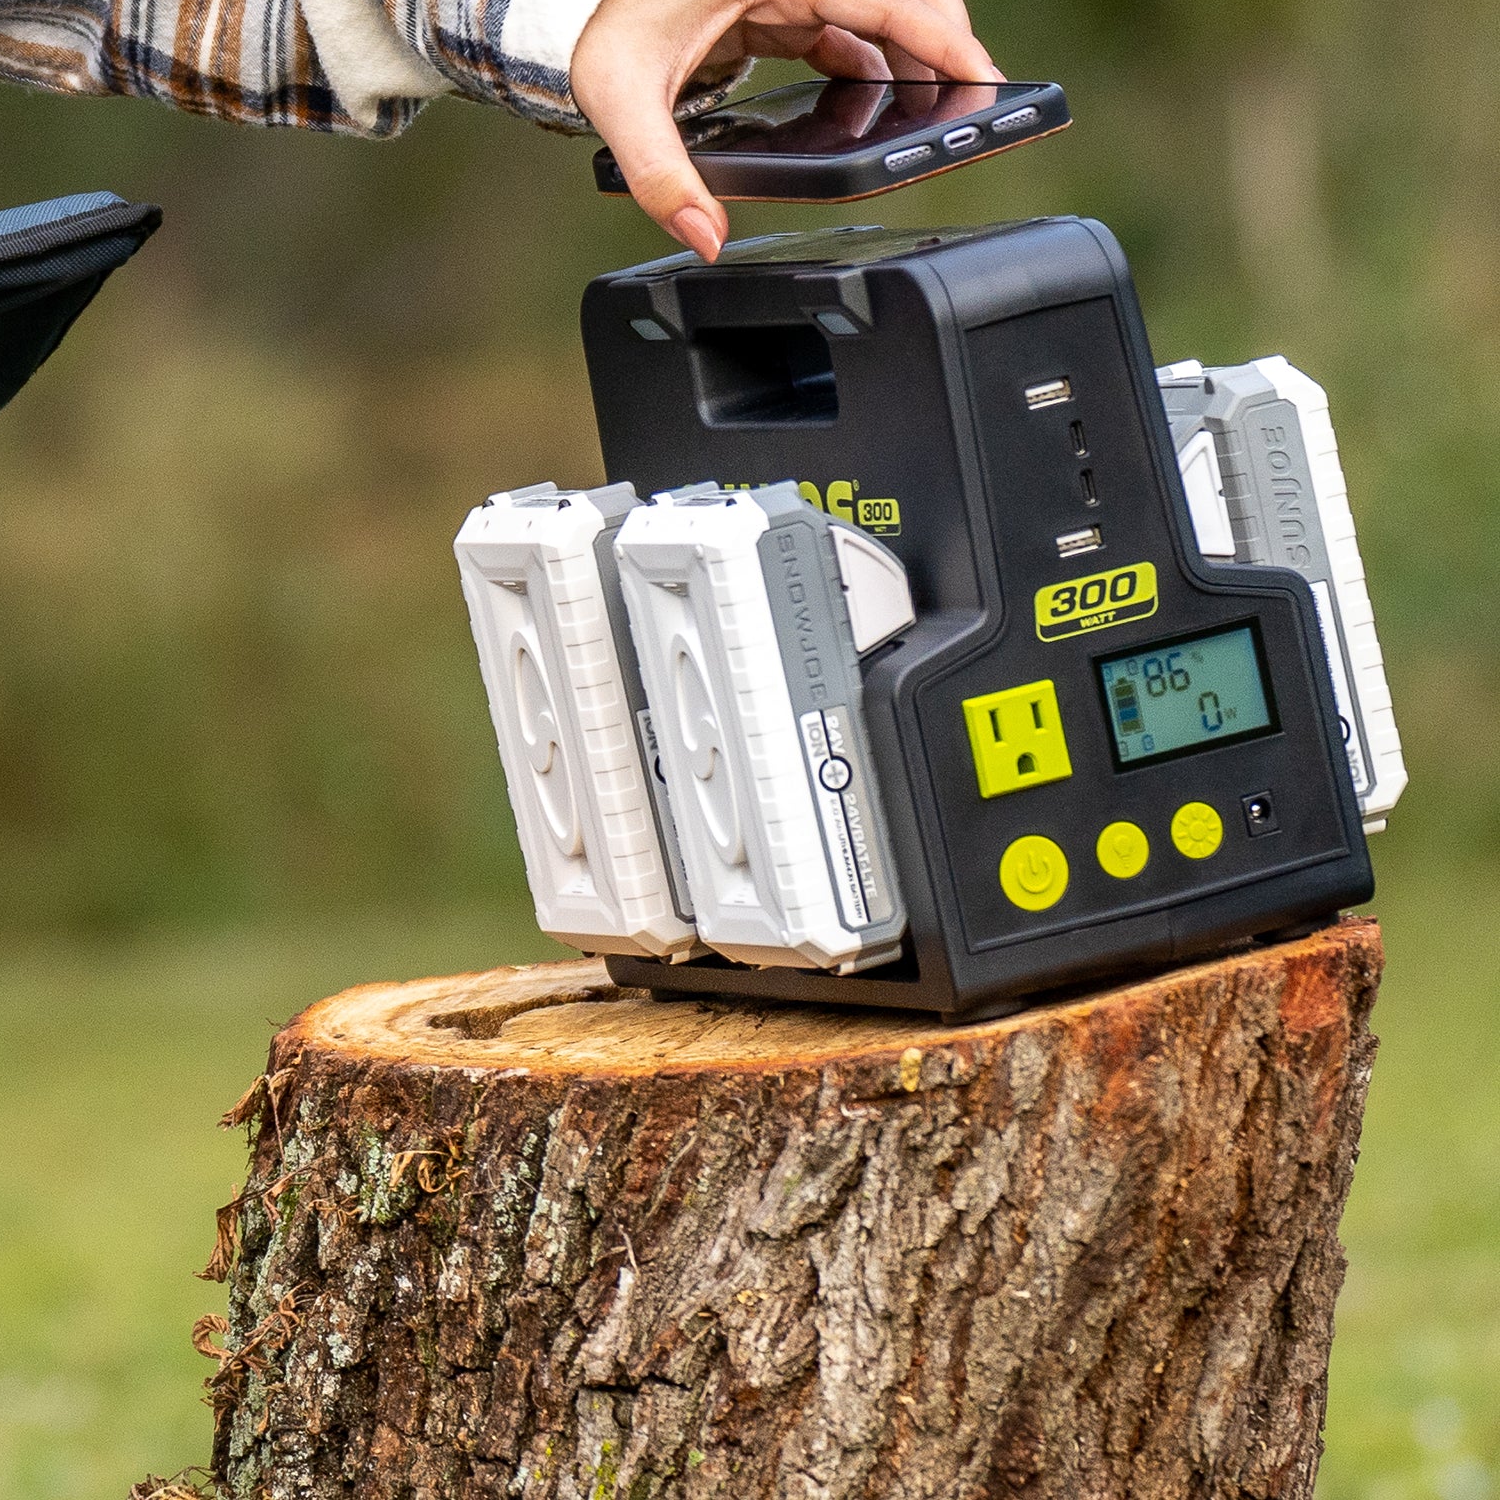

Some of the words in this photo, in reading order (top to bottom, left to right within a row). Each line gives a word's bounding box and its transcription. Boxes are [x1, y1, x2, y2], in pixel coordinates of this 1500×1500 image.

[863, 502, 892, 522] 300
[1261, 426, 1311, 569] SUNJOE
[777, 533, 828, 700] SNOWJOE
[1050, 571, 1138, 618] 300
[1079, 610, 1116, 628] WATT
[1143, 651, 1191, 698] 86
[1199, 691, 1223, 732] 0
[806, 720, 827, 759] ION
